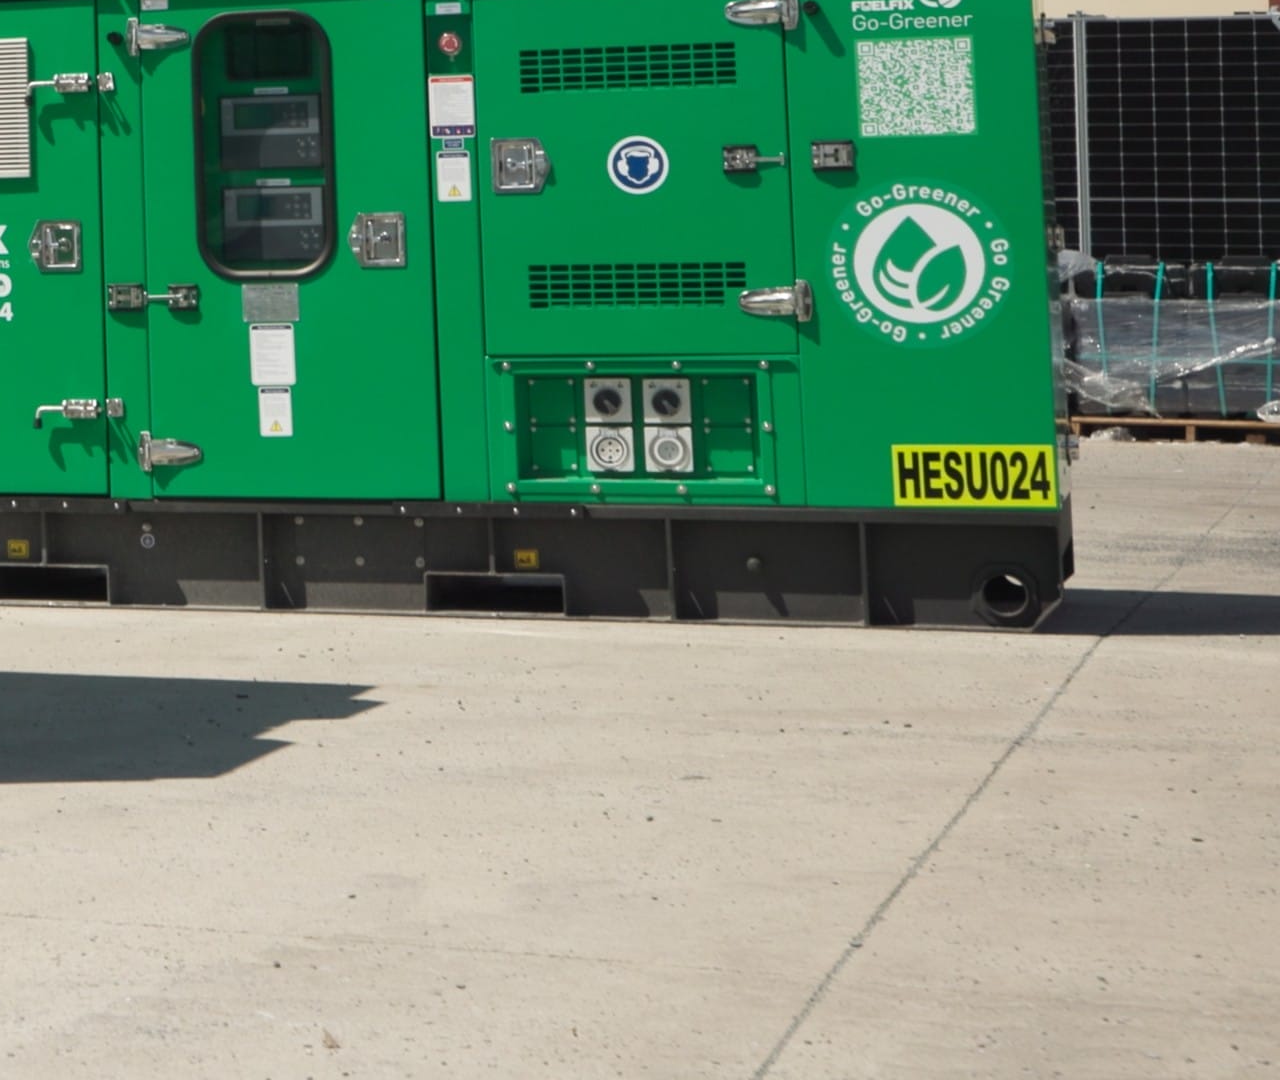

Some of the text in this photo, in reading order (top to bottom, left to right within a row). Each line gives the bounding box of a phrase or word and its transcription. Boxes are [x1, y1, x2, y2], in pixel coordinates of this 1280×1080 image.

[852, 12, 973, 32] Go-Greener
[856, 183, 981, 218] Go-Greener
[832, 242, 907, 342] Go-Greener
[897, 451, 1050, 500] HESU024
